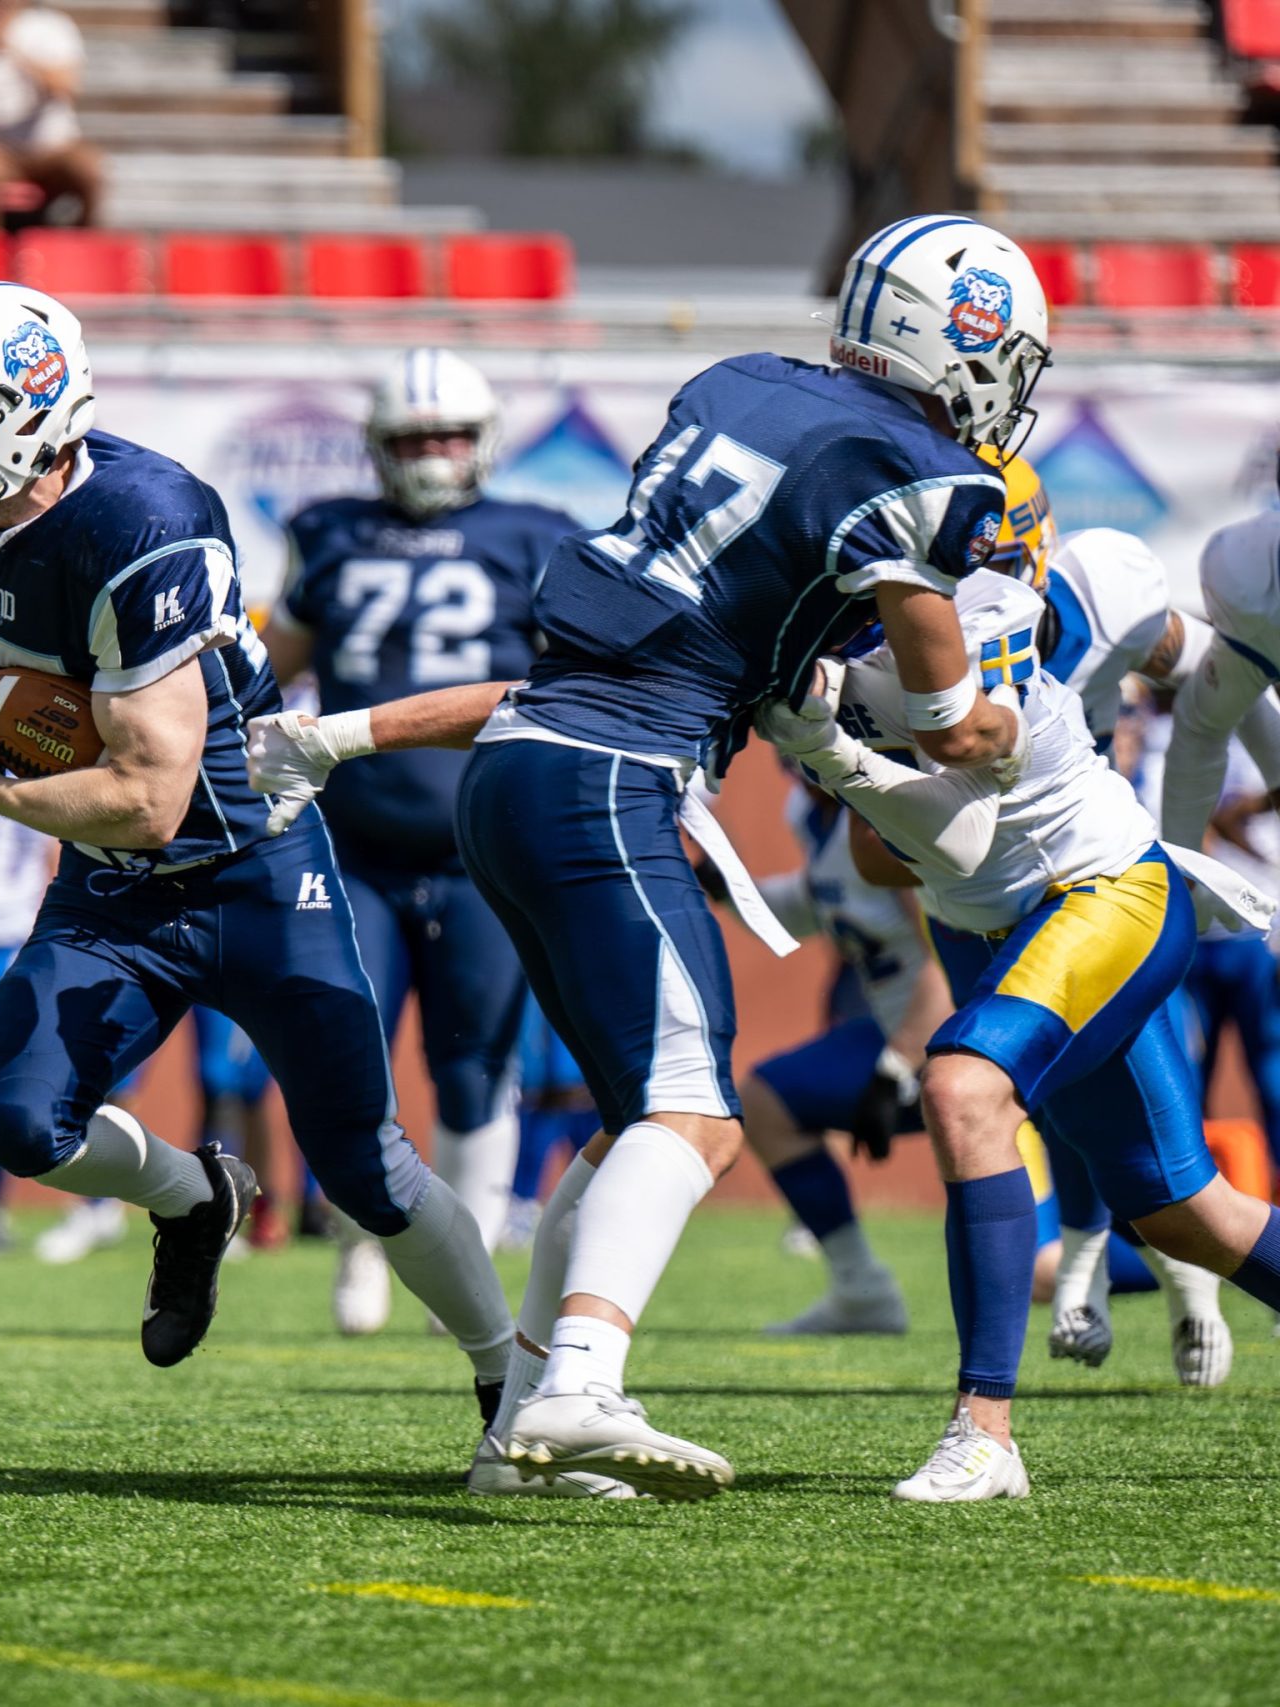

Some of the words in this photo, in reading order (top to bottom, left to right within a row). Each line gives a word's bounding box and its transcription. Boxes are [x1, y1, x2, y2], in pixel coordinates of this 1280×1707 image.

[958, 311, 998, 333] FINLAND
[29, 359, 63, 389] FINLAND
[588, 424, 788, 605] 17
[334, 559, 496, 684] 72
[53, 695, 80, 712] NCAA
[16, 721, 75, 764] Wilson
